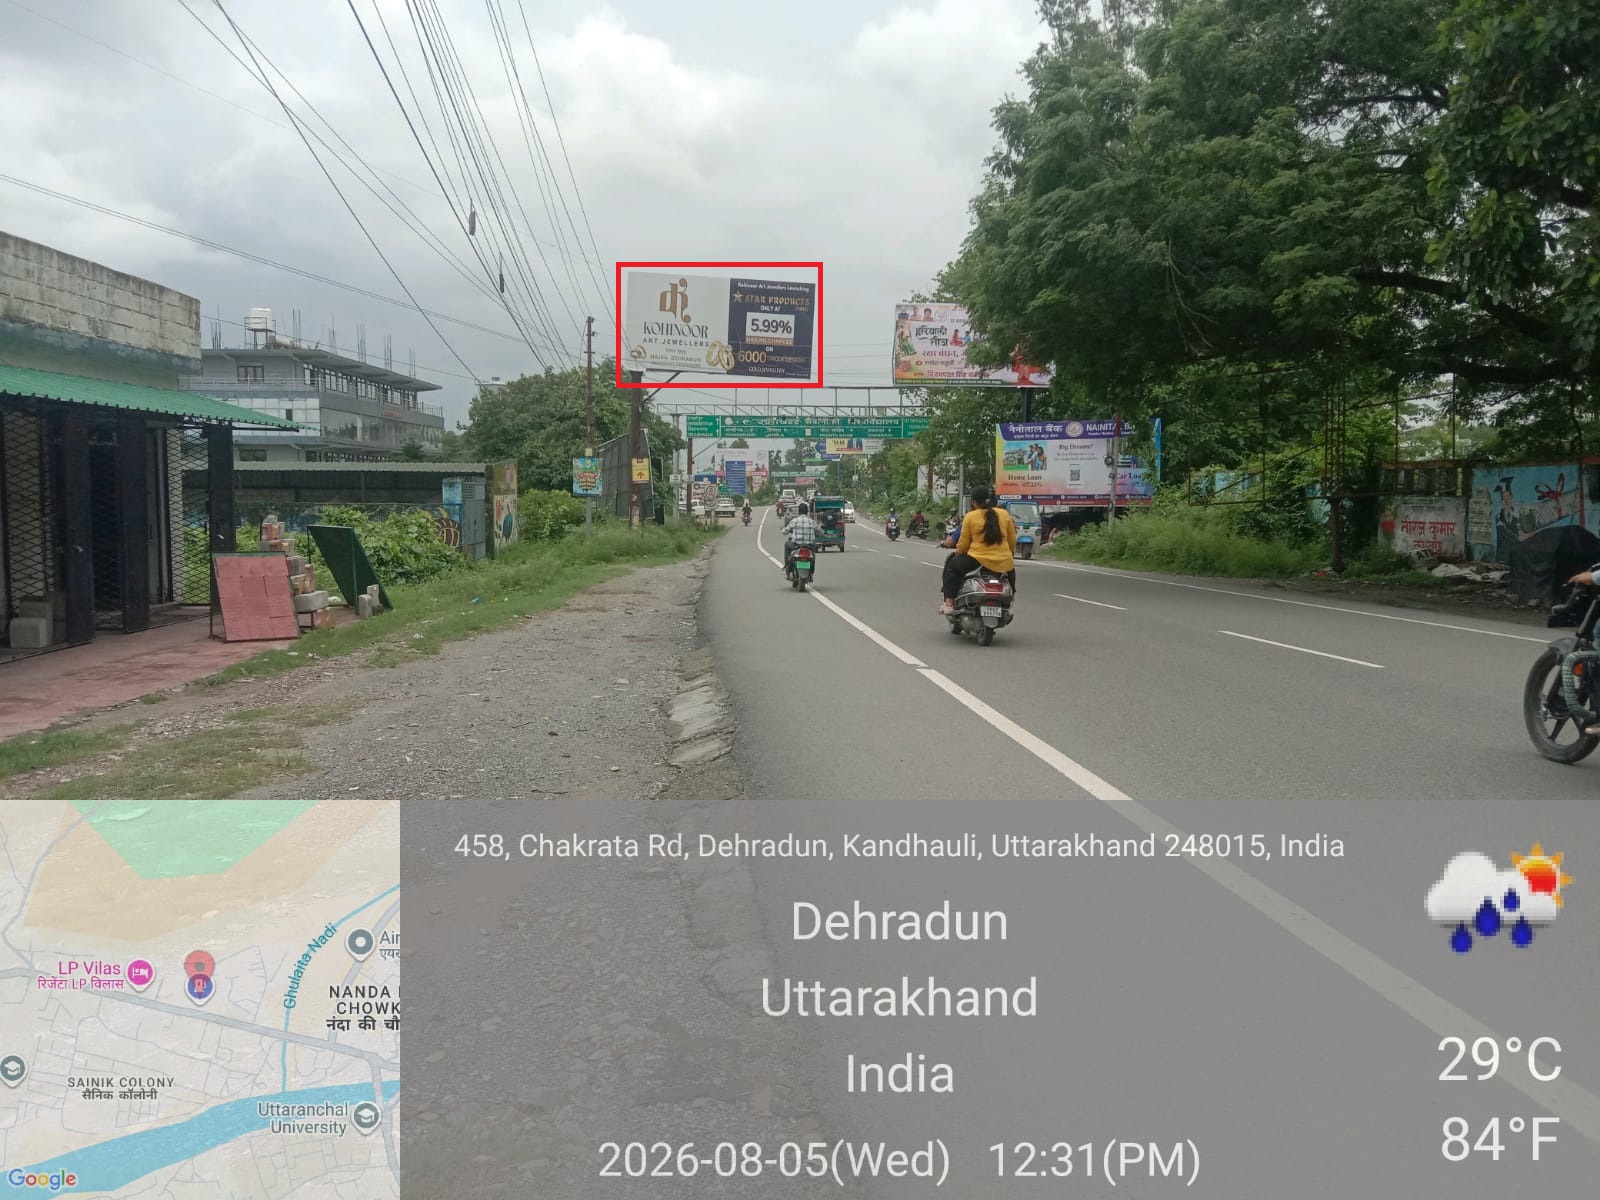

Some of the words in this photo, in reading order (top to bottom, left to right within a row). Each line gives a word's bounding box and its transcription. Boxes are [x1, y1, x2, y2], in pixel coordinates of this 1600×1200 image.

[745, 294, 766, 303] STAR
[768, 296, 810, 306] PRODUCTS
[643, 321, 709, 339] KOHINOOR
[751, 318, 793, 334] 5.99%
[661, 338, 710, 347] JEWELLERS
[929, 336, 948, 347] तीज
[738, 350, 767, 363] 6000
[1086, 423, 1121, 432] NAINITA
[1027, 473, 1042, 481] Loan
[1428, 521, 1456, 540] कुमार
